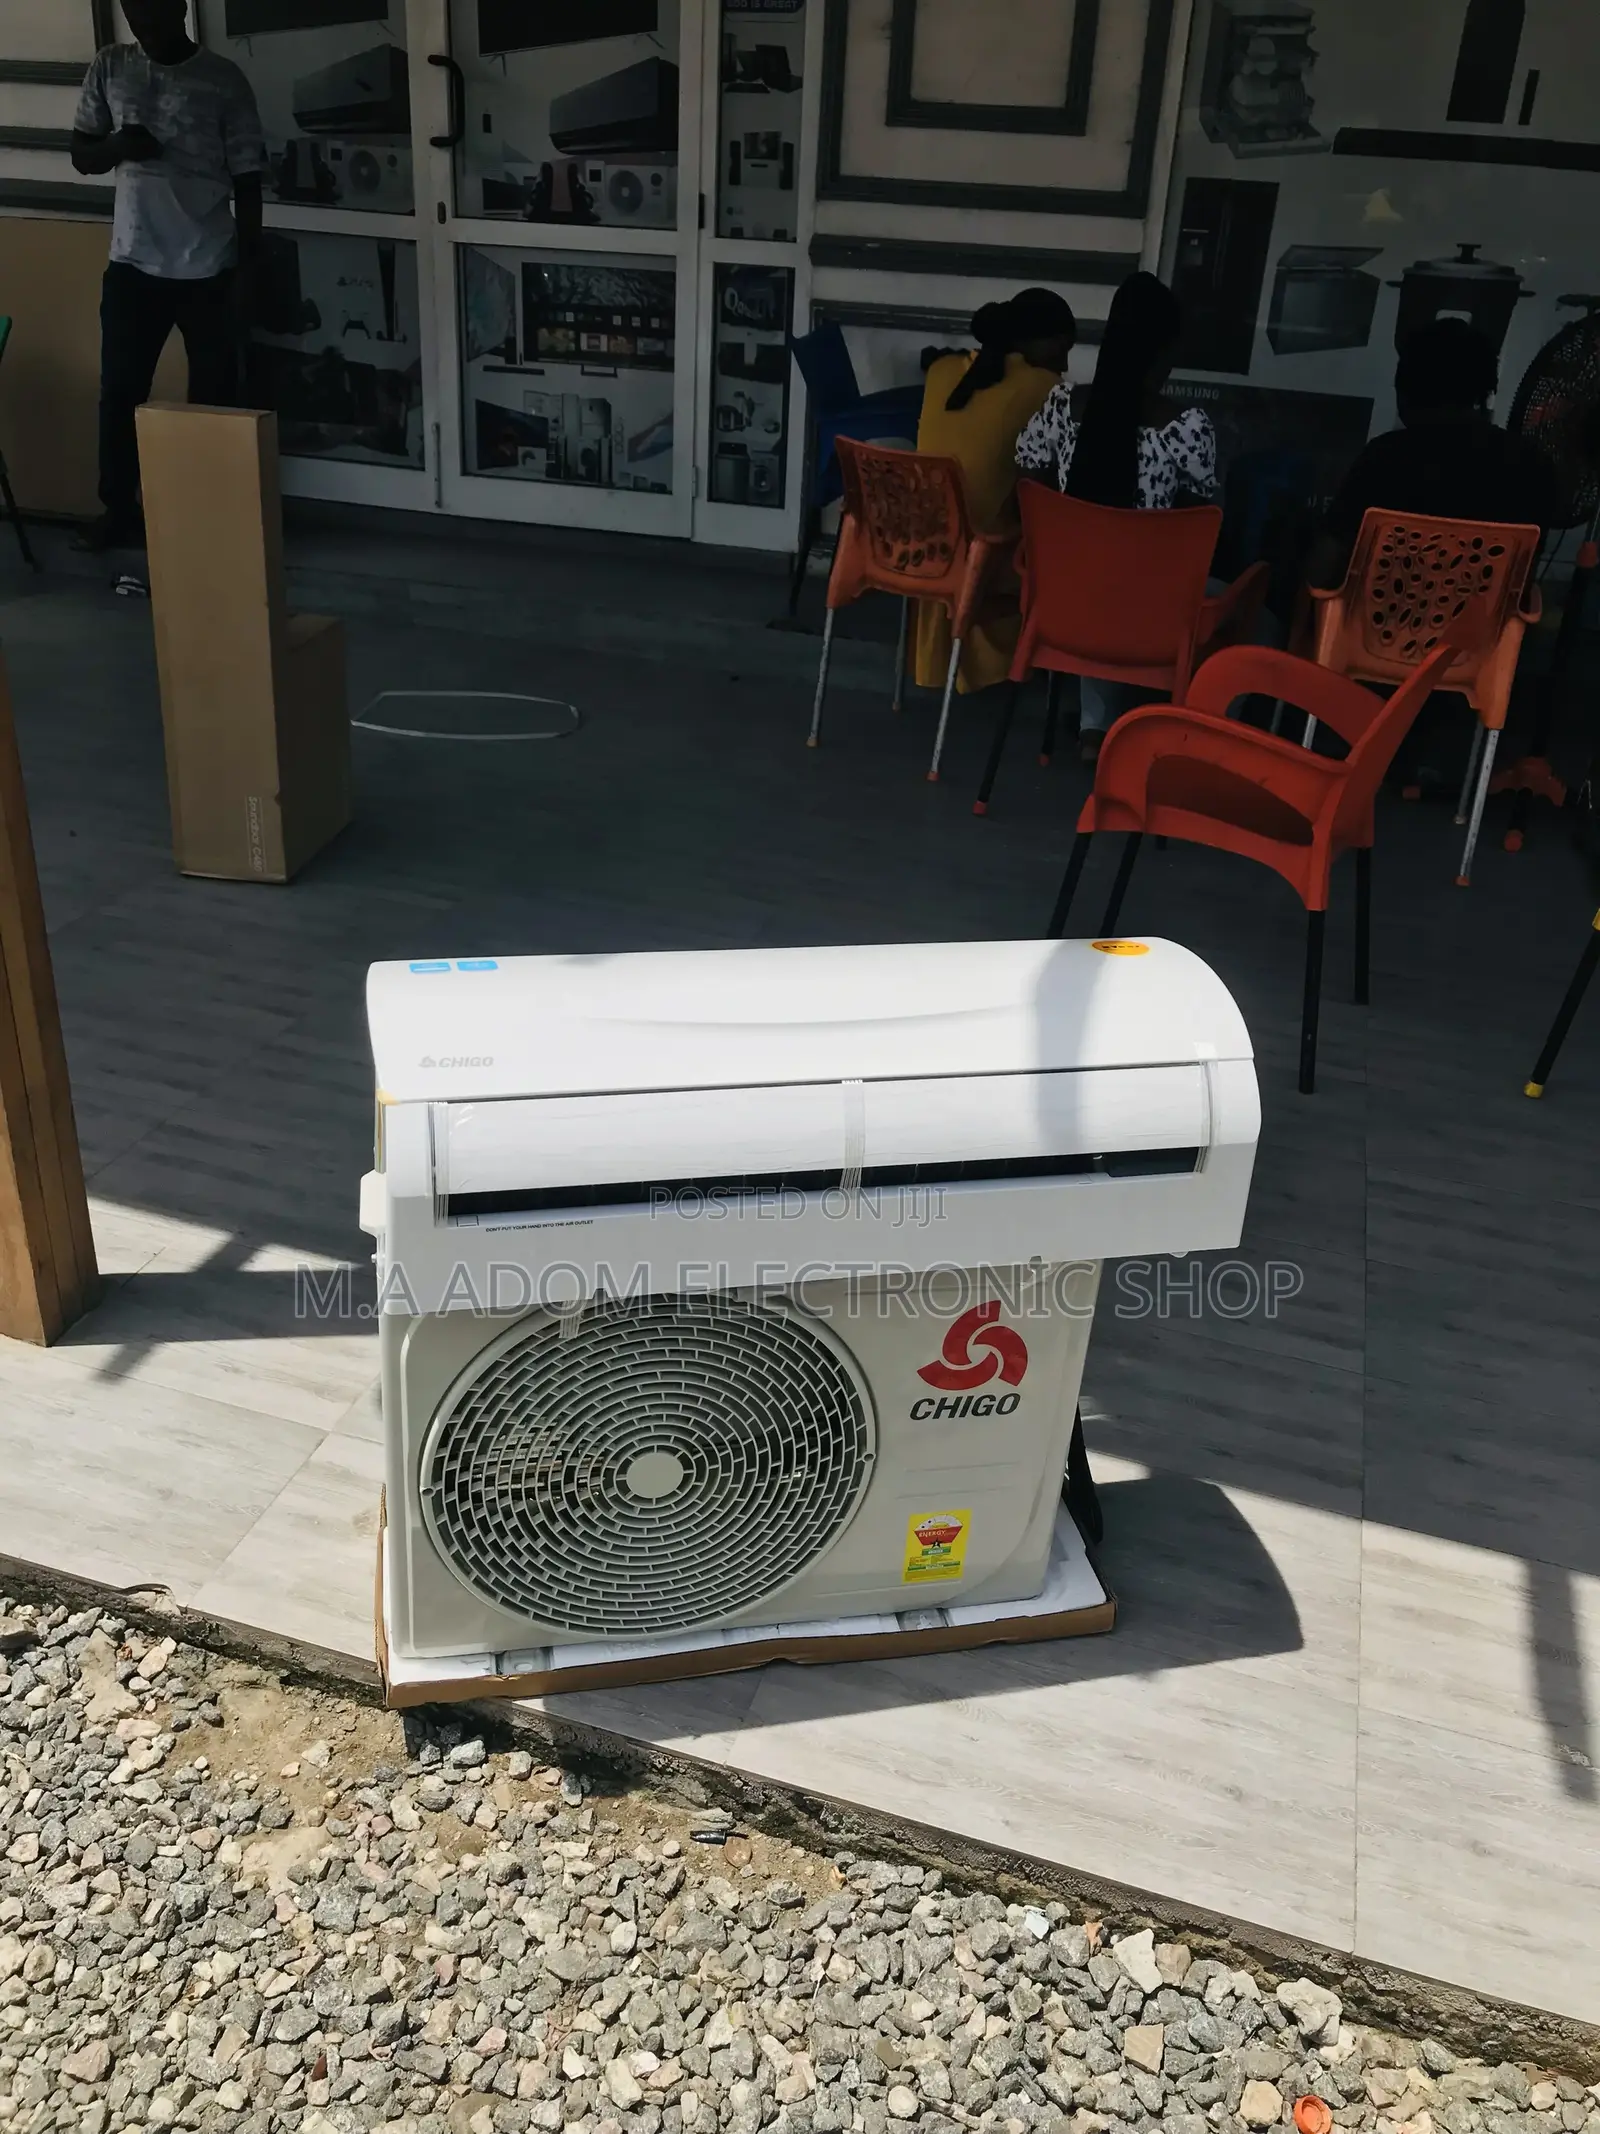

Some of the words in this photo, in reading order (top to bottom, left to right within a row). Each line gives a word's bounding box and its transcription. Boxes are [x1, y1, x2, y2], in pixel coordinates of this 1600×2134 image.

[438, 1056, 494, 1068] CHIGO
[910, 1392, 1021, 1421] CHIGO
[918, 1529, 946, 1537] ENERGY
